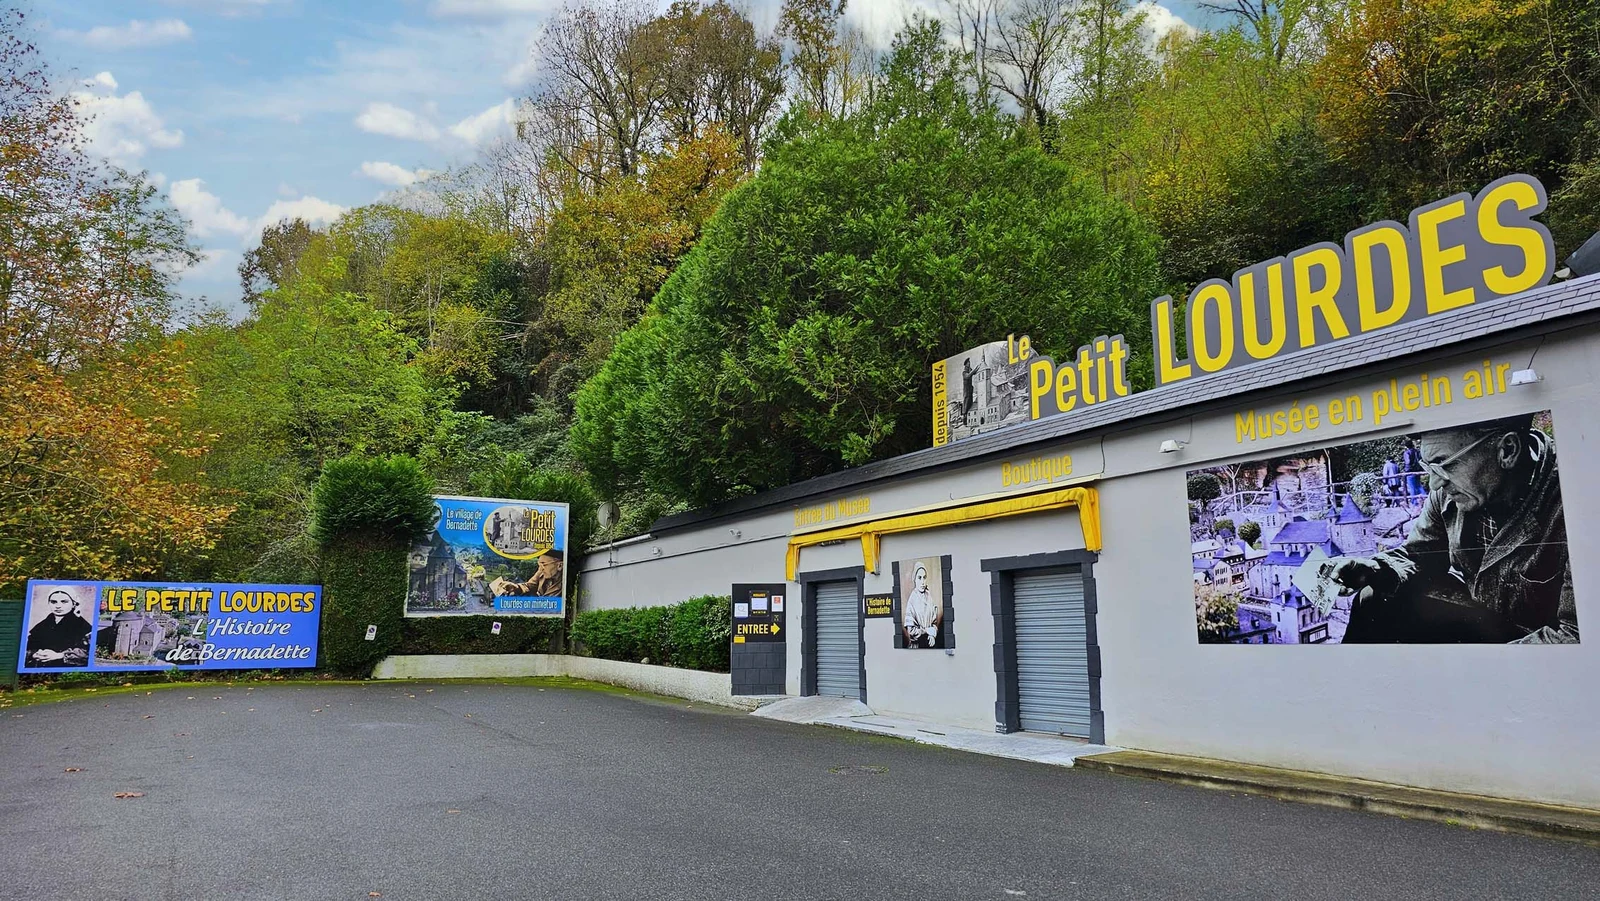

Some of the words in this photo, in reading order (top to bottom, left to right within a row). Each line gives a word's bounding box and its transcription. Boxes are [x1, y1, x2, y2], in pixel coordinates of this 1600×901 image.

[1008, 334, 1030, 364] Le
[1030, 339, 1128, 420] Petit
[1156, 182, 1547, 384] LOURDES
[934, 364, 944, 397] 1954
[1234, 400, 1320, 443] Musée
[1328, 394, 1363, 425] en
[1373, 375, 1453, 426] plein
[1463, 360, 1511, 400] air
[935, 399, 947, 444] depuis
[1002, 455, 1073, 487] Boutique
[446, 508, 454, 518] Le
[455, 508, 473, 521] village
[473, 509, 482, 520] de
[530, 509, 556, 529] Petit
[794, 503, 823, 526] Entrée
[824, 501, 836, 521] du
[837, 494, 871, 518] Musée
[446, 519, 478, 531] Bernadette
[521, 528, 555, 543] LOURDES
[107, 590, 136, 612] LE
[145, 590, 212, 612] PETIT
[219, 591, 315, 613] LOURDES
[500, 599, 522, 609] Lourdes
[523, 600, 531, 609] en
[531, 599, 557, 609] miniature
[737, 624, 769, 634] ENTREE
[165, 645, 191, 661] de
[199, 643, 311, 661] Bernadette
